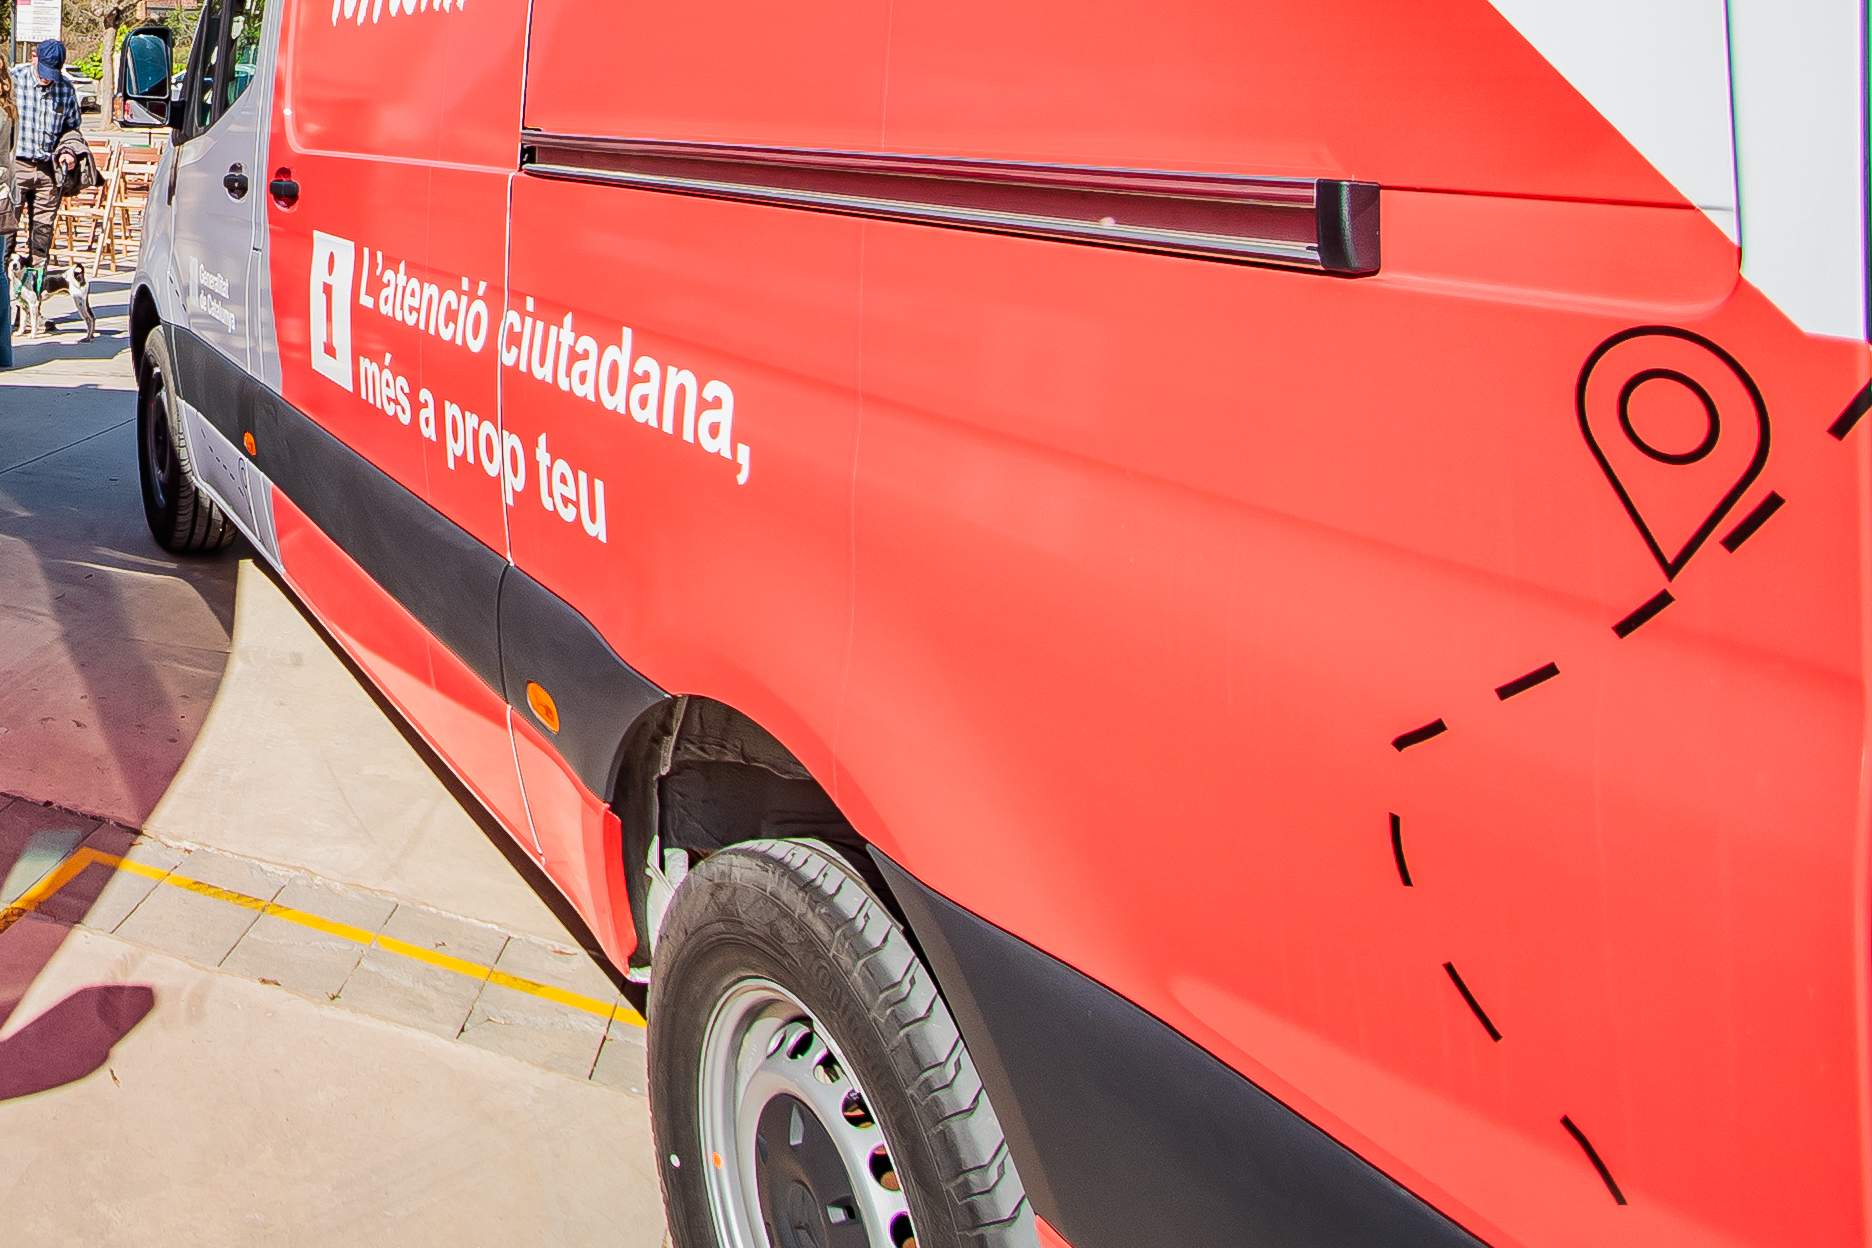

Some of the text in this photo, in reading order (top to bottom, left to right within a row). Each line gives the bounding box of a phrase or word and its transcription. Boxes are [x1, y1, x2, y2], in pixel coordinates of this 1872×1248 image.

[359, 246, 752, 486] L'atenció ciutadana,
[359, 352, 608, 544] més a prop teu
